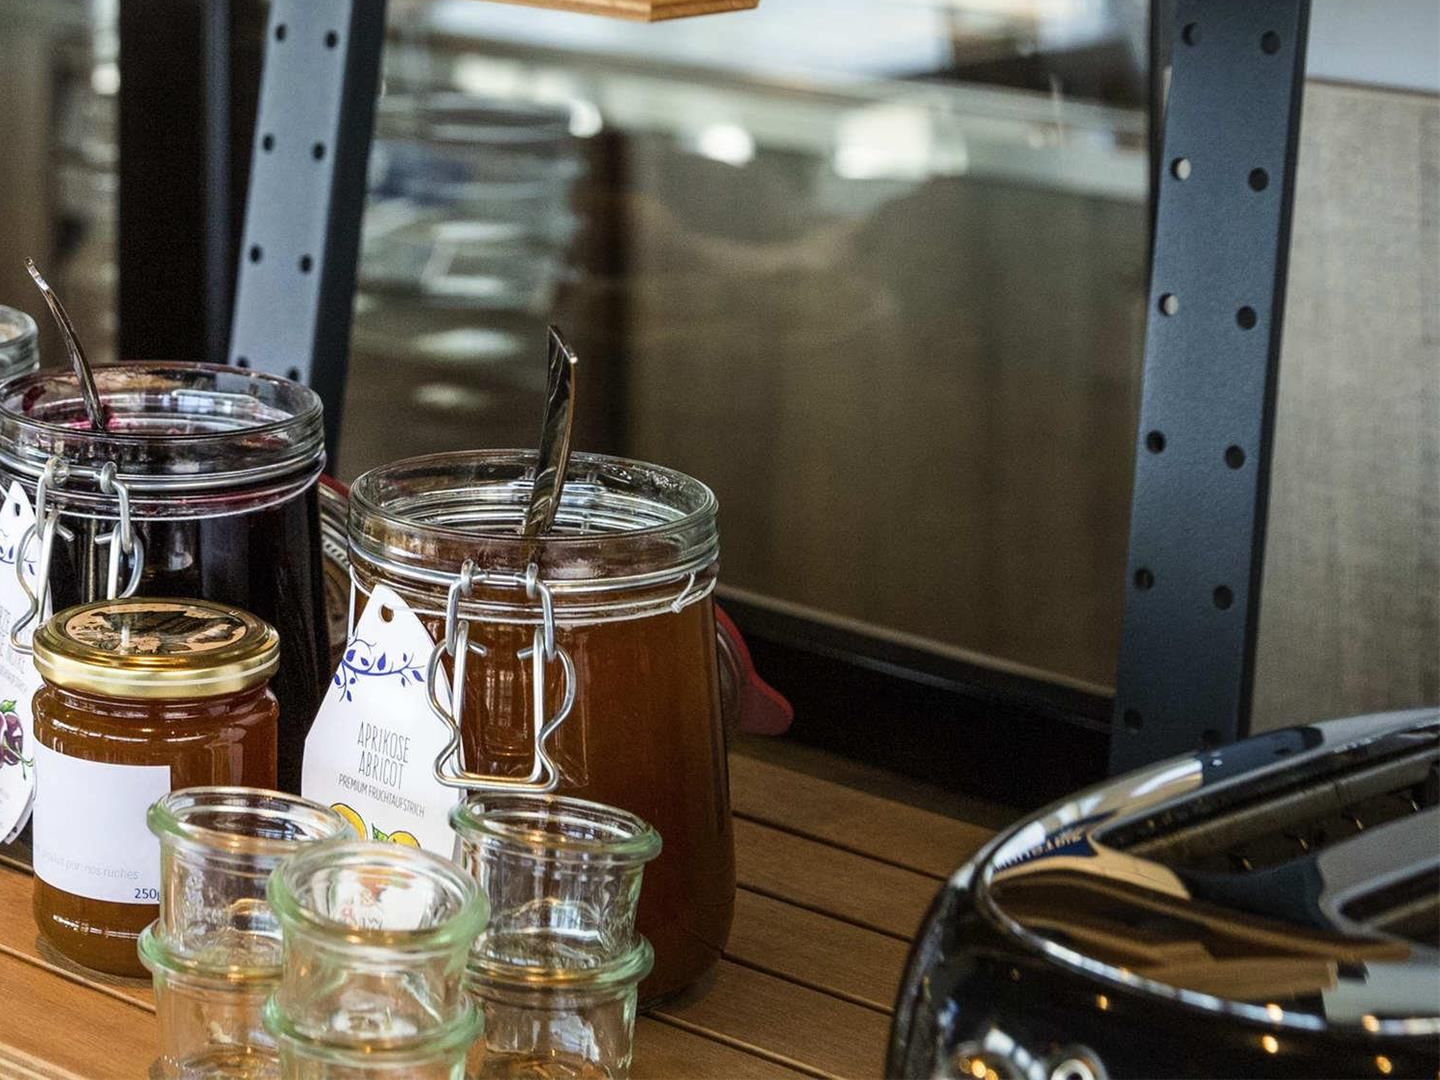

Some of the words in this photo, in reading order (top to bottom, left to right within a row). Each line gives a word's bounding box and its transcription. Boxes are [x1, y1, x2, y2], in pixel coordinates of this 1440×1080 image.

[357, 721, 410, 763] APRIKOSE
[358, 751, 404, 789] ABRICOT
[338, 773, 367, 793] PREMIUM
[368, 785, 425, 817] FRUCHTAUFSTRICH
[103, 864, 140, 880] ruches
